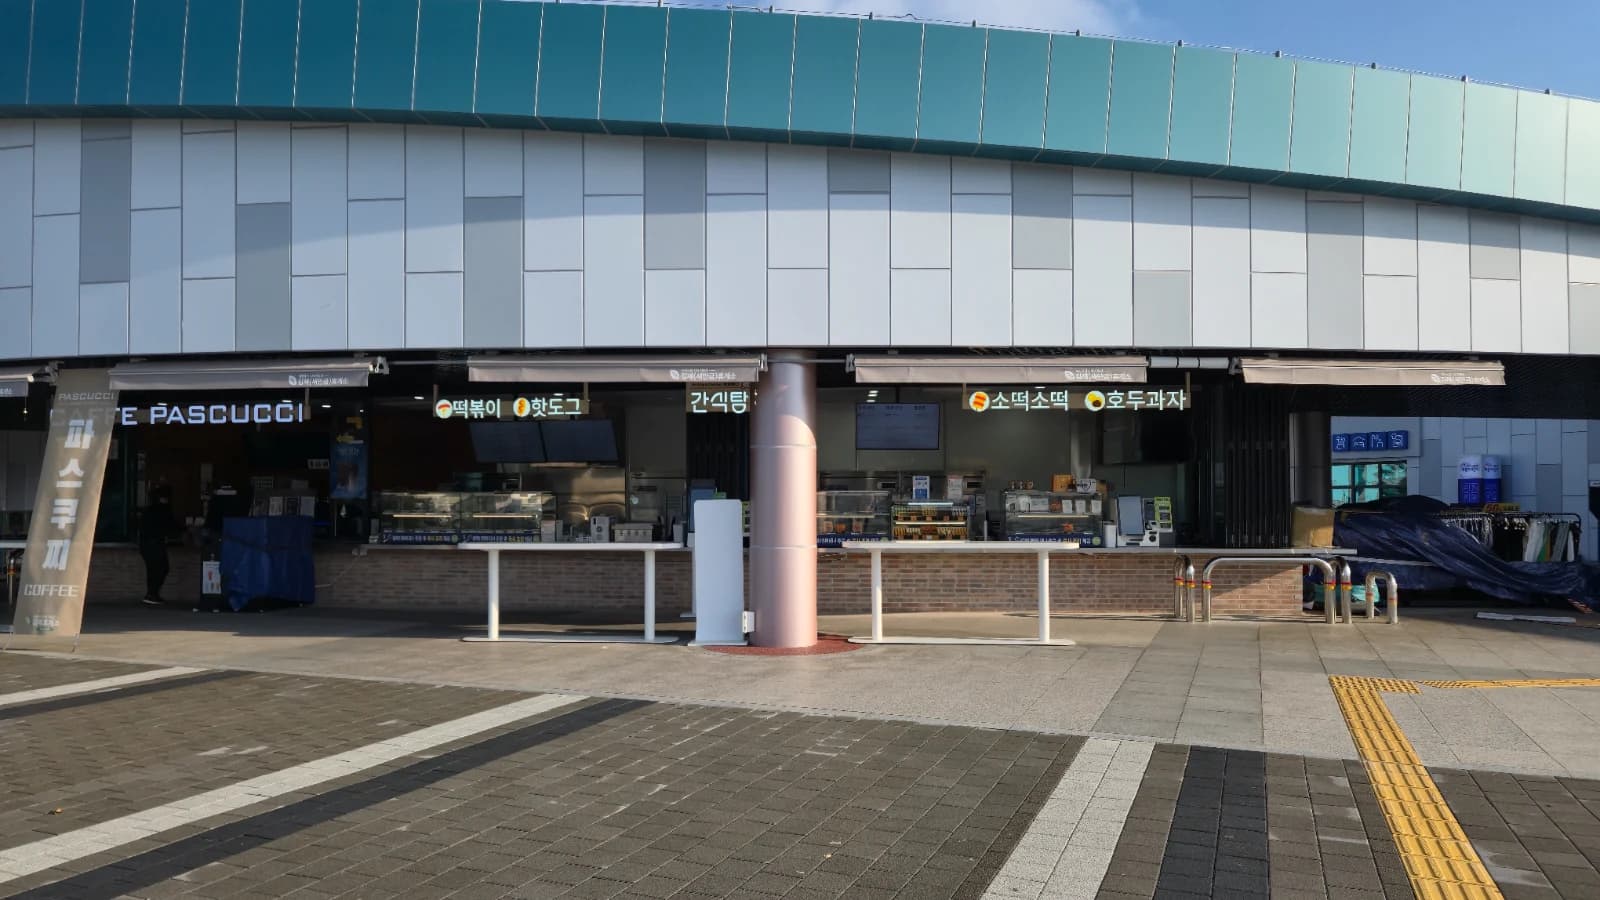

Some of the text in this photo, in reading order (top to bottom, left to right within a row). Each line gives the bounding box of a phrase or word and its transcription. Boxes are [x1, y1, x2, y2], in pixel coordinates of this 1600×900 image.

[58, 392, 114, 401] PASCUCCI
[990, 388, 1187, 411] 소떡소떡 호두과자
[149, 403, 303, 425] PASCUCCI
[452, 397, 582, 419] 떡볶이 핫도그
[42, 418, 95, 571] 파스쿠찌
[23, 583, 80, 598] COFFEE
